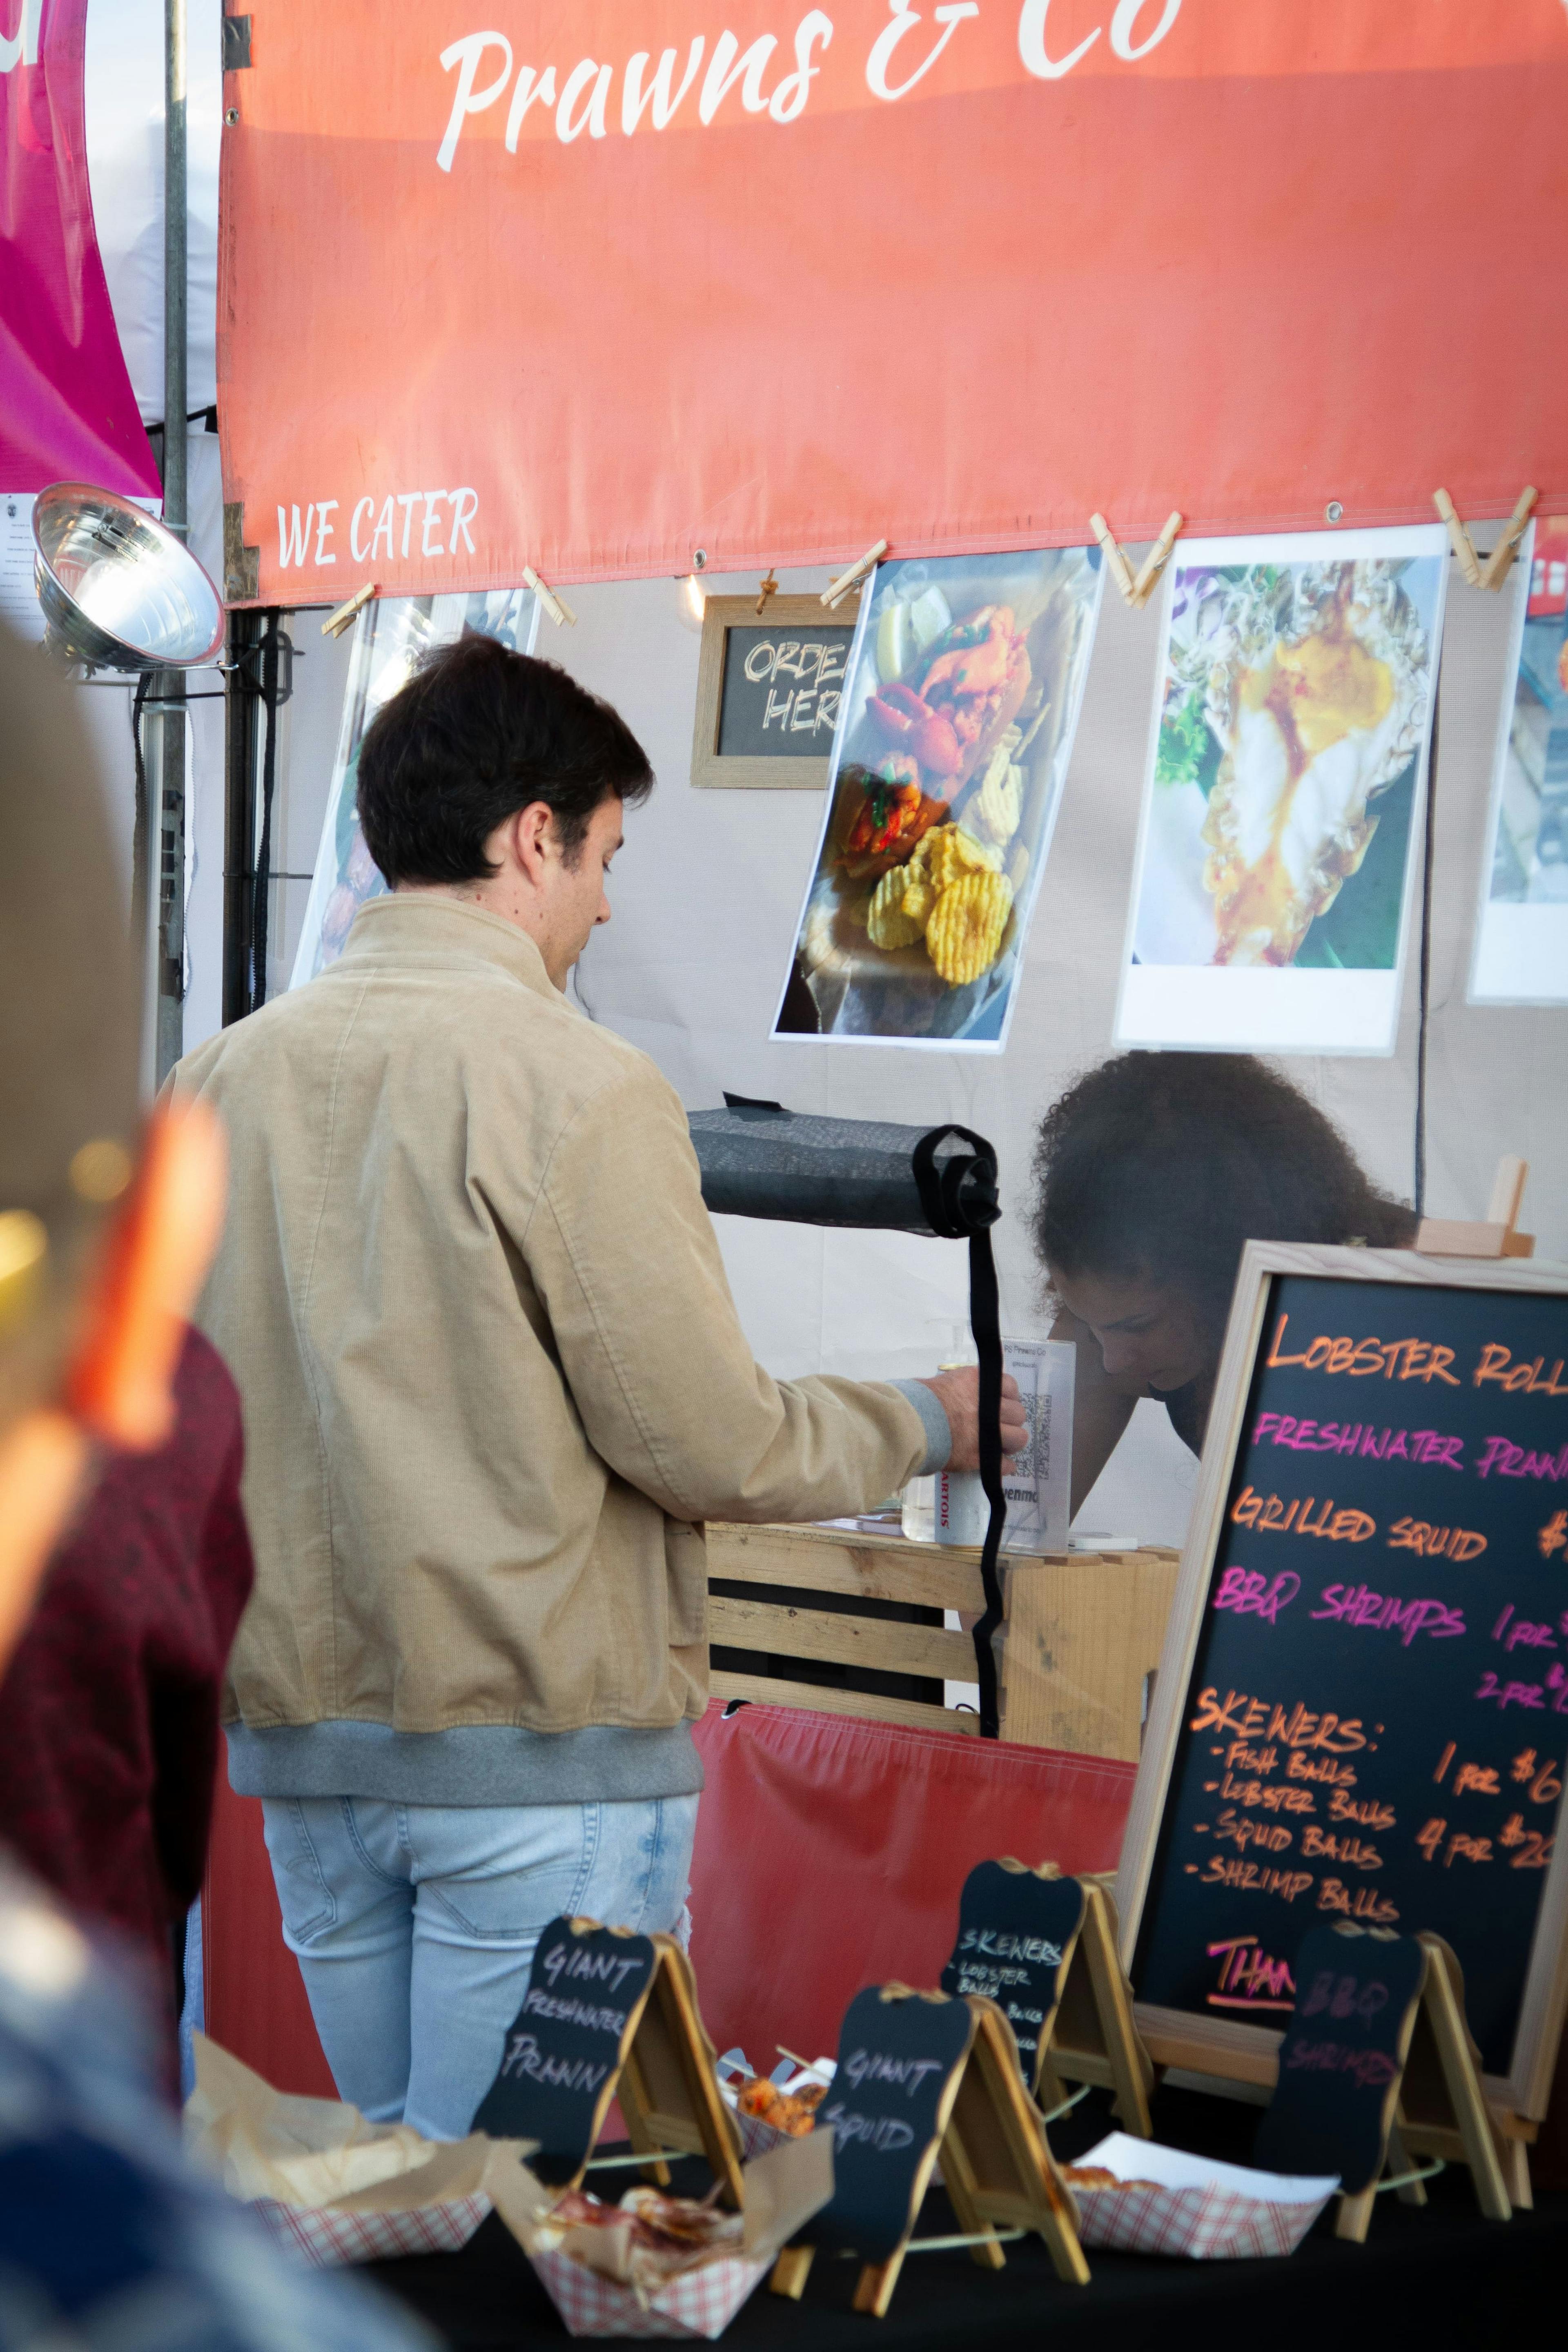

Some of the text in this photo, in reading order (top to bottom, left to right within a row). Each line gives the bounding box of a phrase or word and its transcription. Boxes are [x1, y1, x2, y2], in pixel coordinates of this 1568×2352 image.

[436, 9, 833, 172] Prawns
[866, 0, 978, 100] &
[278, 487, 478, 568] WE CATER
[744, 640, 853, 688] ORDE
[762, 689, 842, 736] HER
[1266, 1313, 1461, 1385] LOBSTER
[1251, 1411, 1464, 1471] FRESHWATER
[1232, 1486, 1376, 1542] GRILLED
[1388, 1516, 1488, 1561] SQUID
[1214, 1566, 1301, 1625] BBQ
[1309, 1583, 1467, 1646] SHRIMPS
[1227, 1740, 1357, 1787] FISH BALLS
[1510, 1746, 1561, 1804] $6
[1220, 1771, 1396, 1831] LOBSTER BALLS
[1213, 1807, 1383, 1870] SQUID BALLS
[1200, 1855, 1401, 1921] SHRIMP BALLS
[542, 1942, 645, 1993] GIANT
[956, 1977, 999, 1998] BALLS
[959, 1961, 1031, 1986] LOBSTER
[501, 2033, 608, 2092] PRAWN
[844, 2047, 942, 2098] GIANT
[823, 2101, 915, 2154] SQUID
